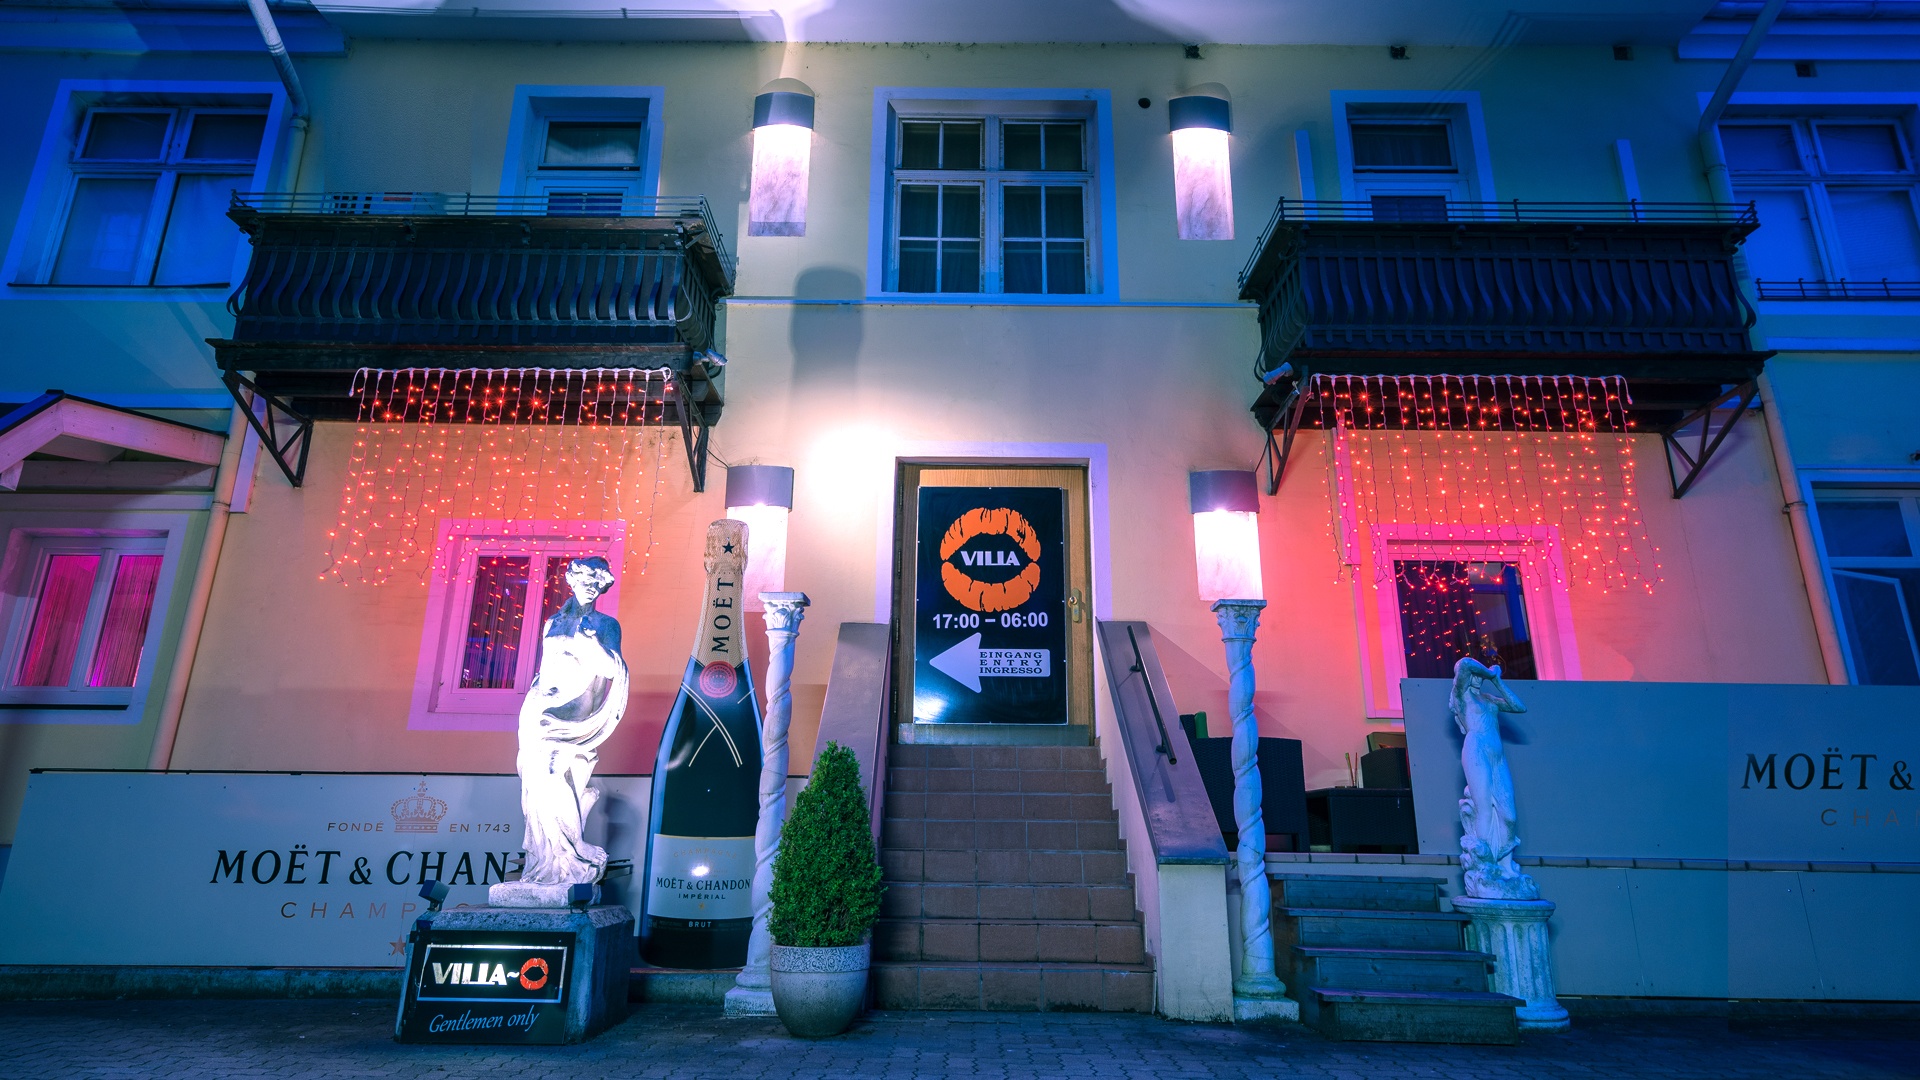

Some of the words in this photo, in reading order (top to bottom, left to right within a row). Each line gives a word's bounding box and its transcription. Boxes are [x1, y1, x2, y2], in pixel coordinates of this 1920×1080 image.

[960, 550, 1021, 567] VILLA
[711, 578, 735, 653] MOËT
[932, 613, 980, 629] 17:00
[1001, 612, 1048, 628] 06:00
[979, 651, 1043, 659] EINGANG
[979, 659, 1043, 667] ENTRY
[979, 667, 1043, 675] INGRESSO
[1740, 747, 1878, 790] MOËT
[1889, 760, 1915, 790] &
[327, 819, 384, 833] FONDÉ
[449, 823, 470, 834] EN
[475, 823, 511, 834] 1743
[209, 844, 341, 885] MOËT
[349, 856, 372, 885] &
[656, 877, 684, 889] MOËT
[687, 882, 693, 890] &
[696, 879, 751, 891] CHANDON
[280, 901, 470, 920] CHAMP
[429, 1010, 503, 1033] Gentlemen
[507, 1005, 540, 1032] only
